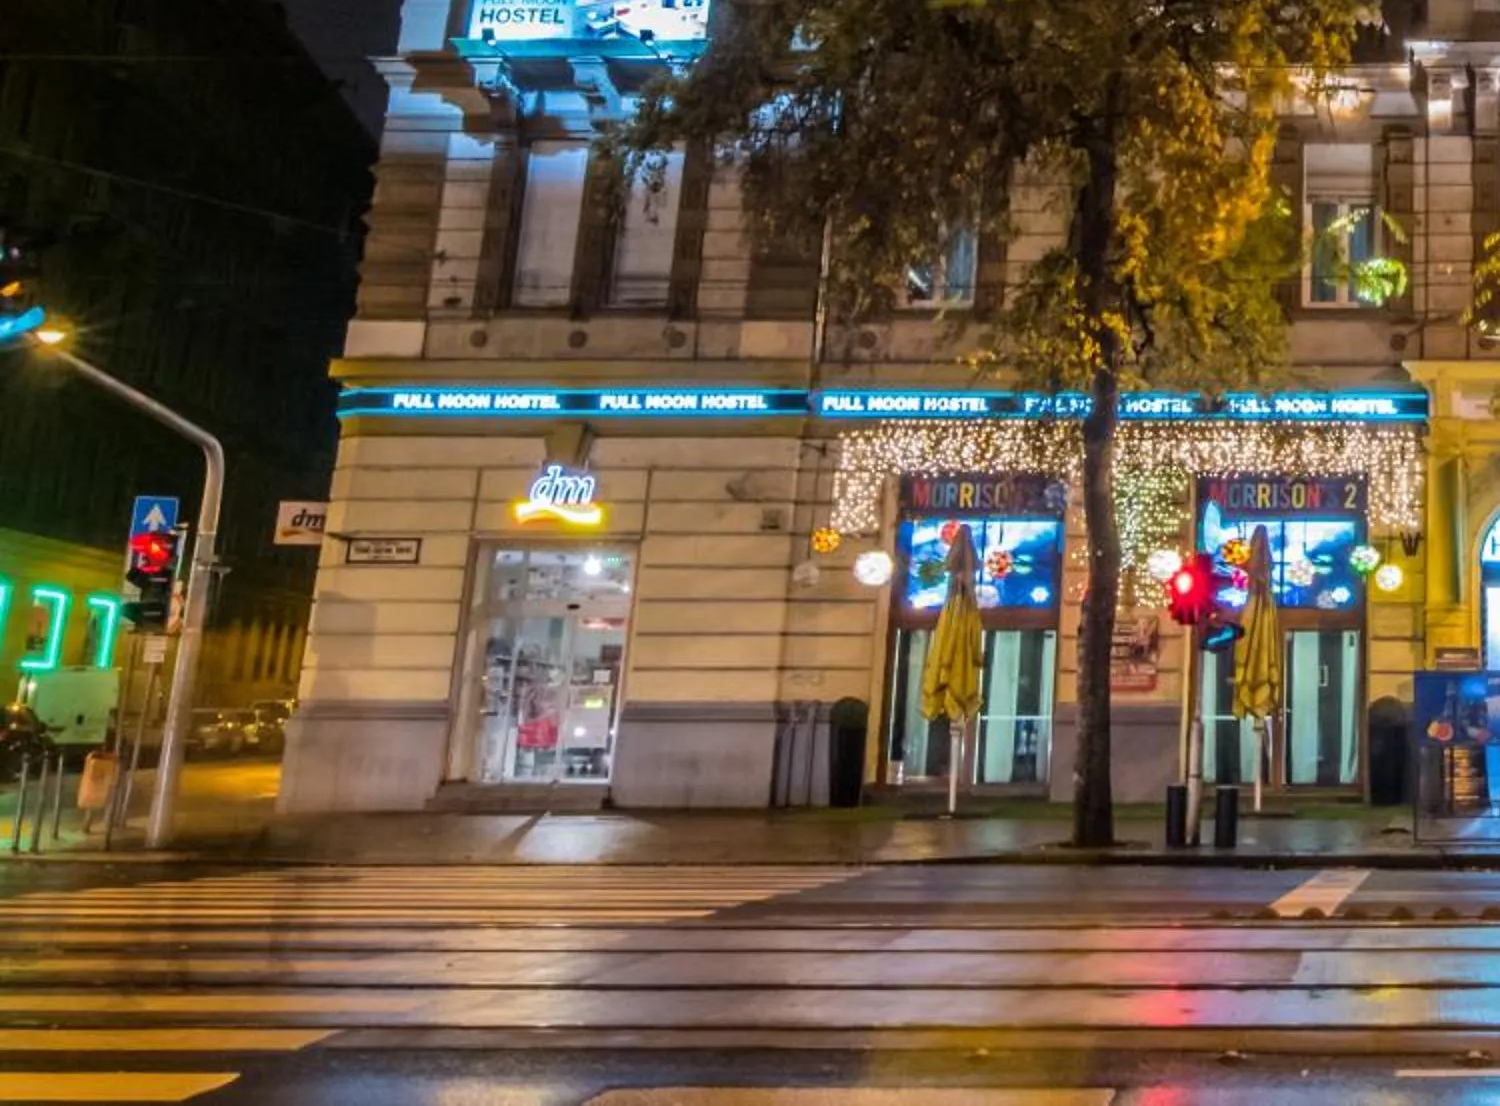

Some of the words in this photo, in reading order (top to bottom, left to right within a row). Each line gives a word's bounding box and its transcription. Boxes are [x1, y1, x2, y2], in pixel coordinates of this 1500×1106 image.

[479, 7, 566, 25] HOSTEL
[393, 394, 434, 409] FULL
[438, 394, 491, 409] MOON
[495, 394, 561, 409] HOSTEL
[599, 394, 642, 409] FULL
[645, 394, 698, 409] MOON
[701, 394, 767, 409] HOSTEL
[822, 396, 864, 411] FULL
[867, 396, 920, 411] MOON
[924, 397, 989, 412] HOSTEL
[1126, 398, 1192, 413] HOSTEL
[1331, 398, 1398, 415] HOSTEL
[530, 465, 595, 506] dm
[913, 481, 1038, 509] MORRISO
[1343, 482, 1358, 510] 2
[290, 507, 326, 528] dm
